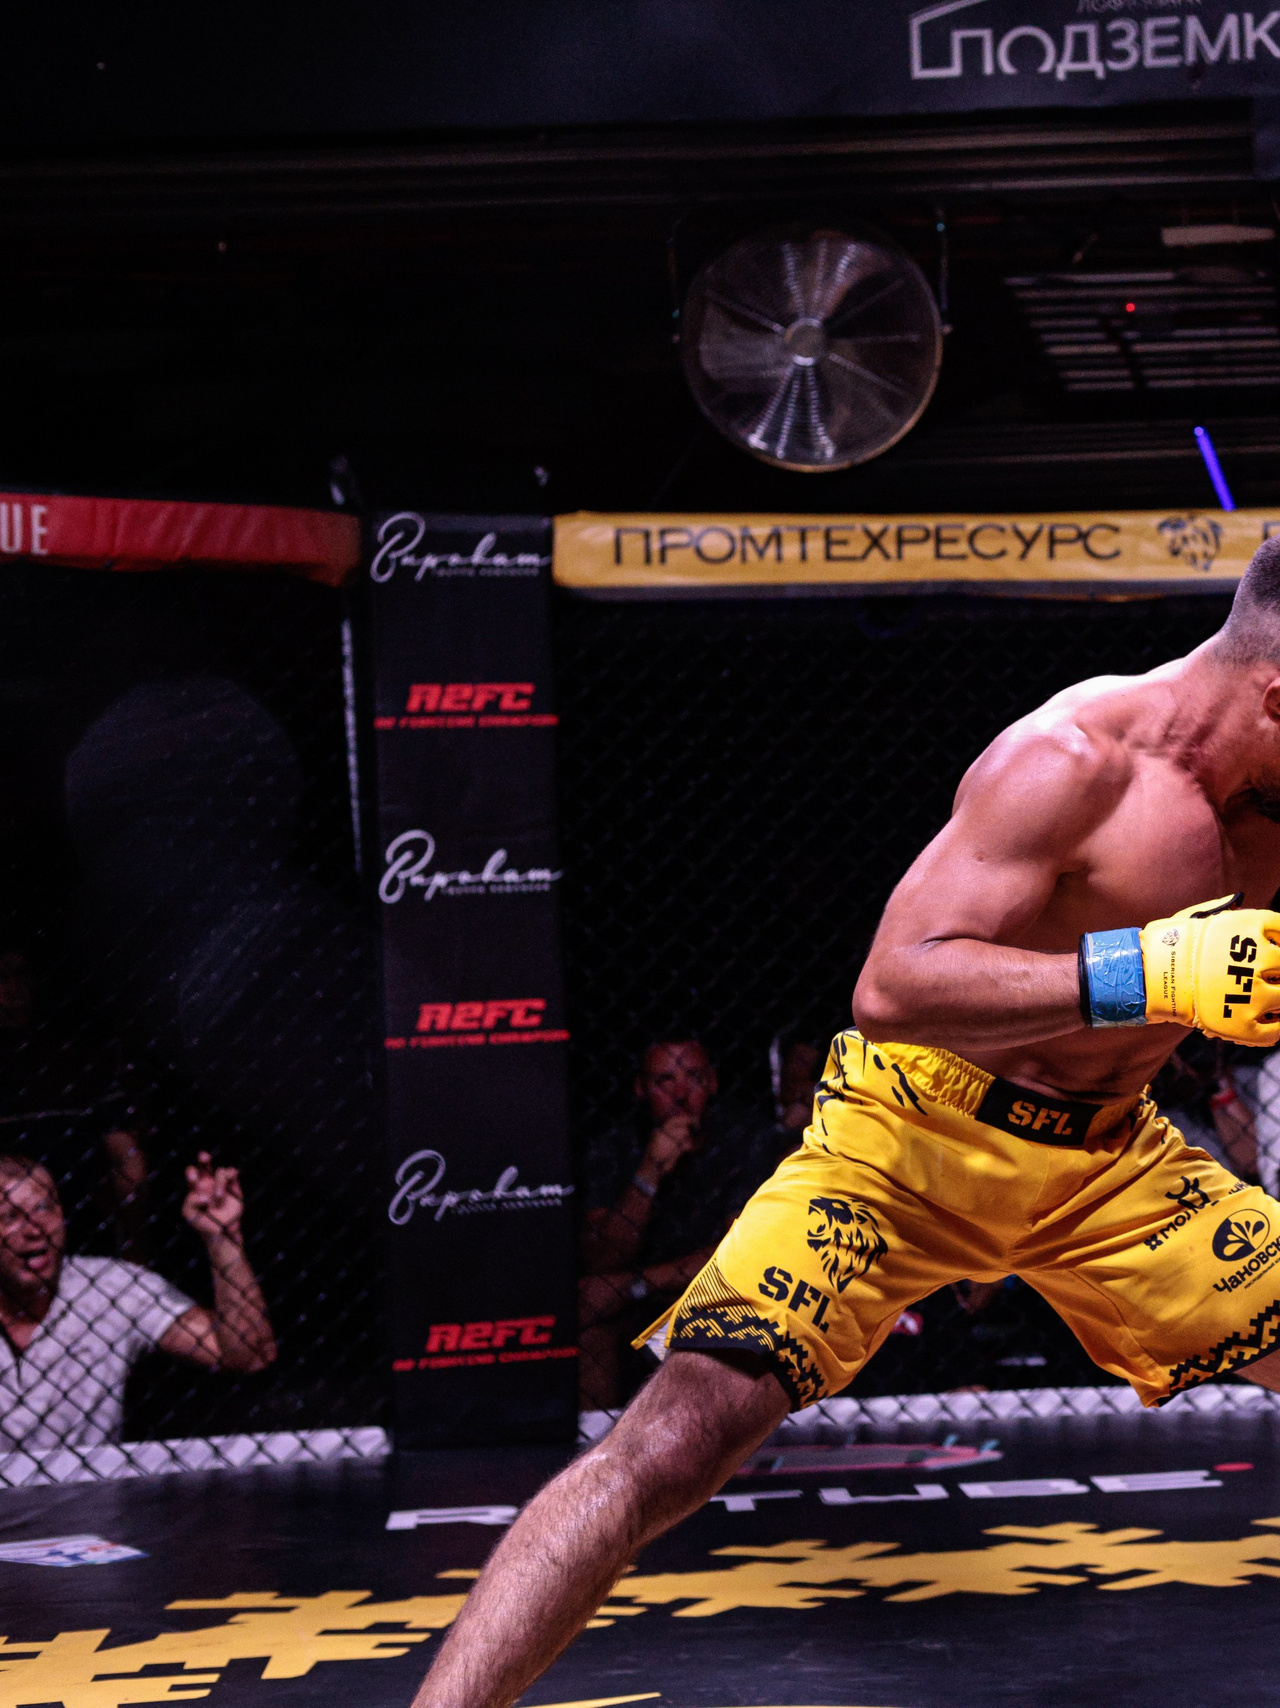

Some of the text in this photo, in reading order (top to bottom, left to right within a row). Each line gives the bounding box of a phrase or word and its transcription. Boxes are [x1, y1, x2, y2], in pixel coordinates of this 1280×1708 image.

[613, 522, 1122, 566] ПРОМТЕХРЕСУРС
[1223, 934, 1258, 1019] SFL
[1007, 1100, 1073, 1136] SFL
[758, 1266, 831, 1334] SFL
[386, 1469, 1223, 1531] RTUBE
